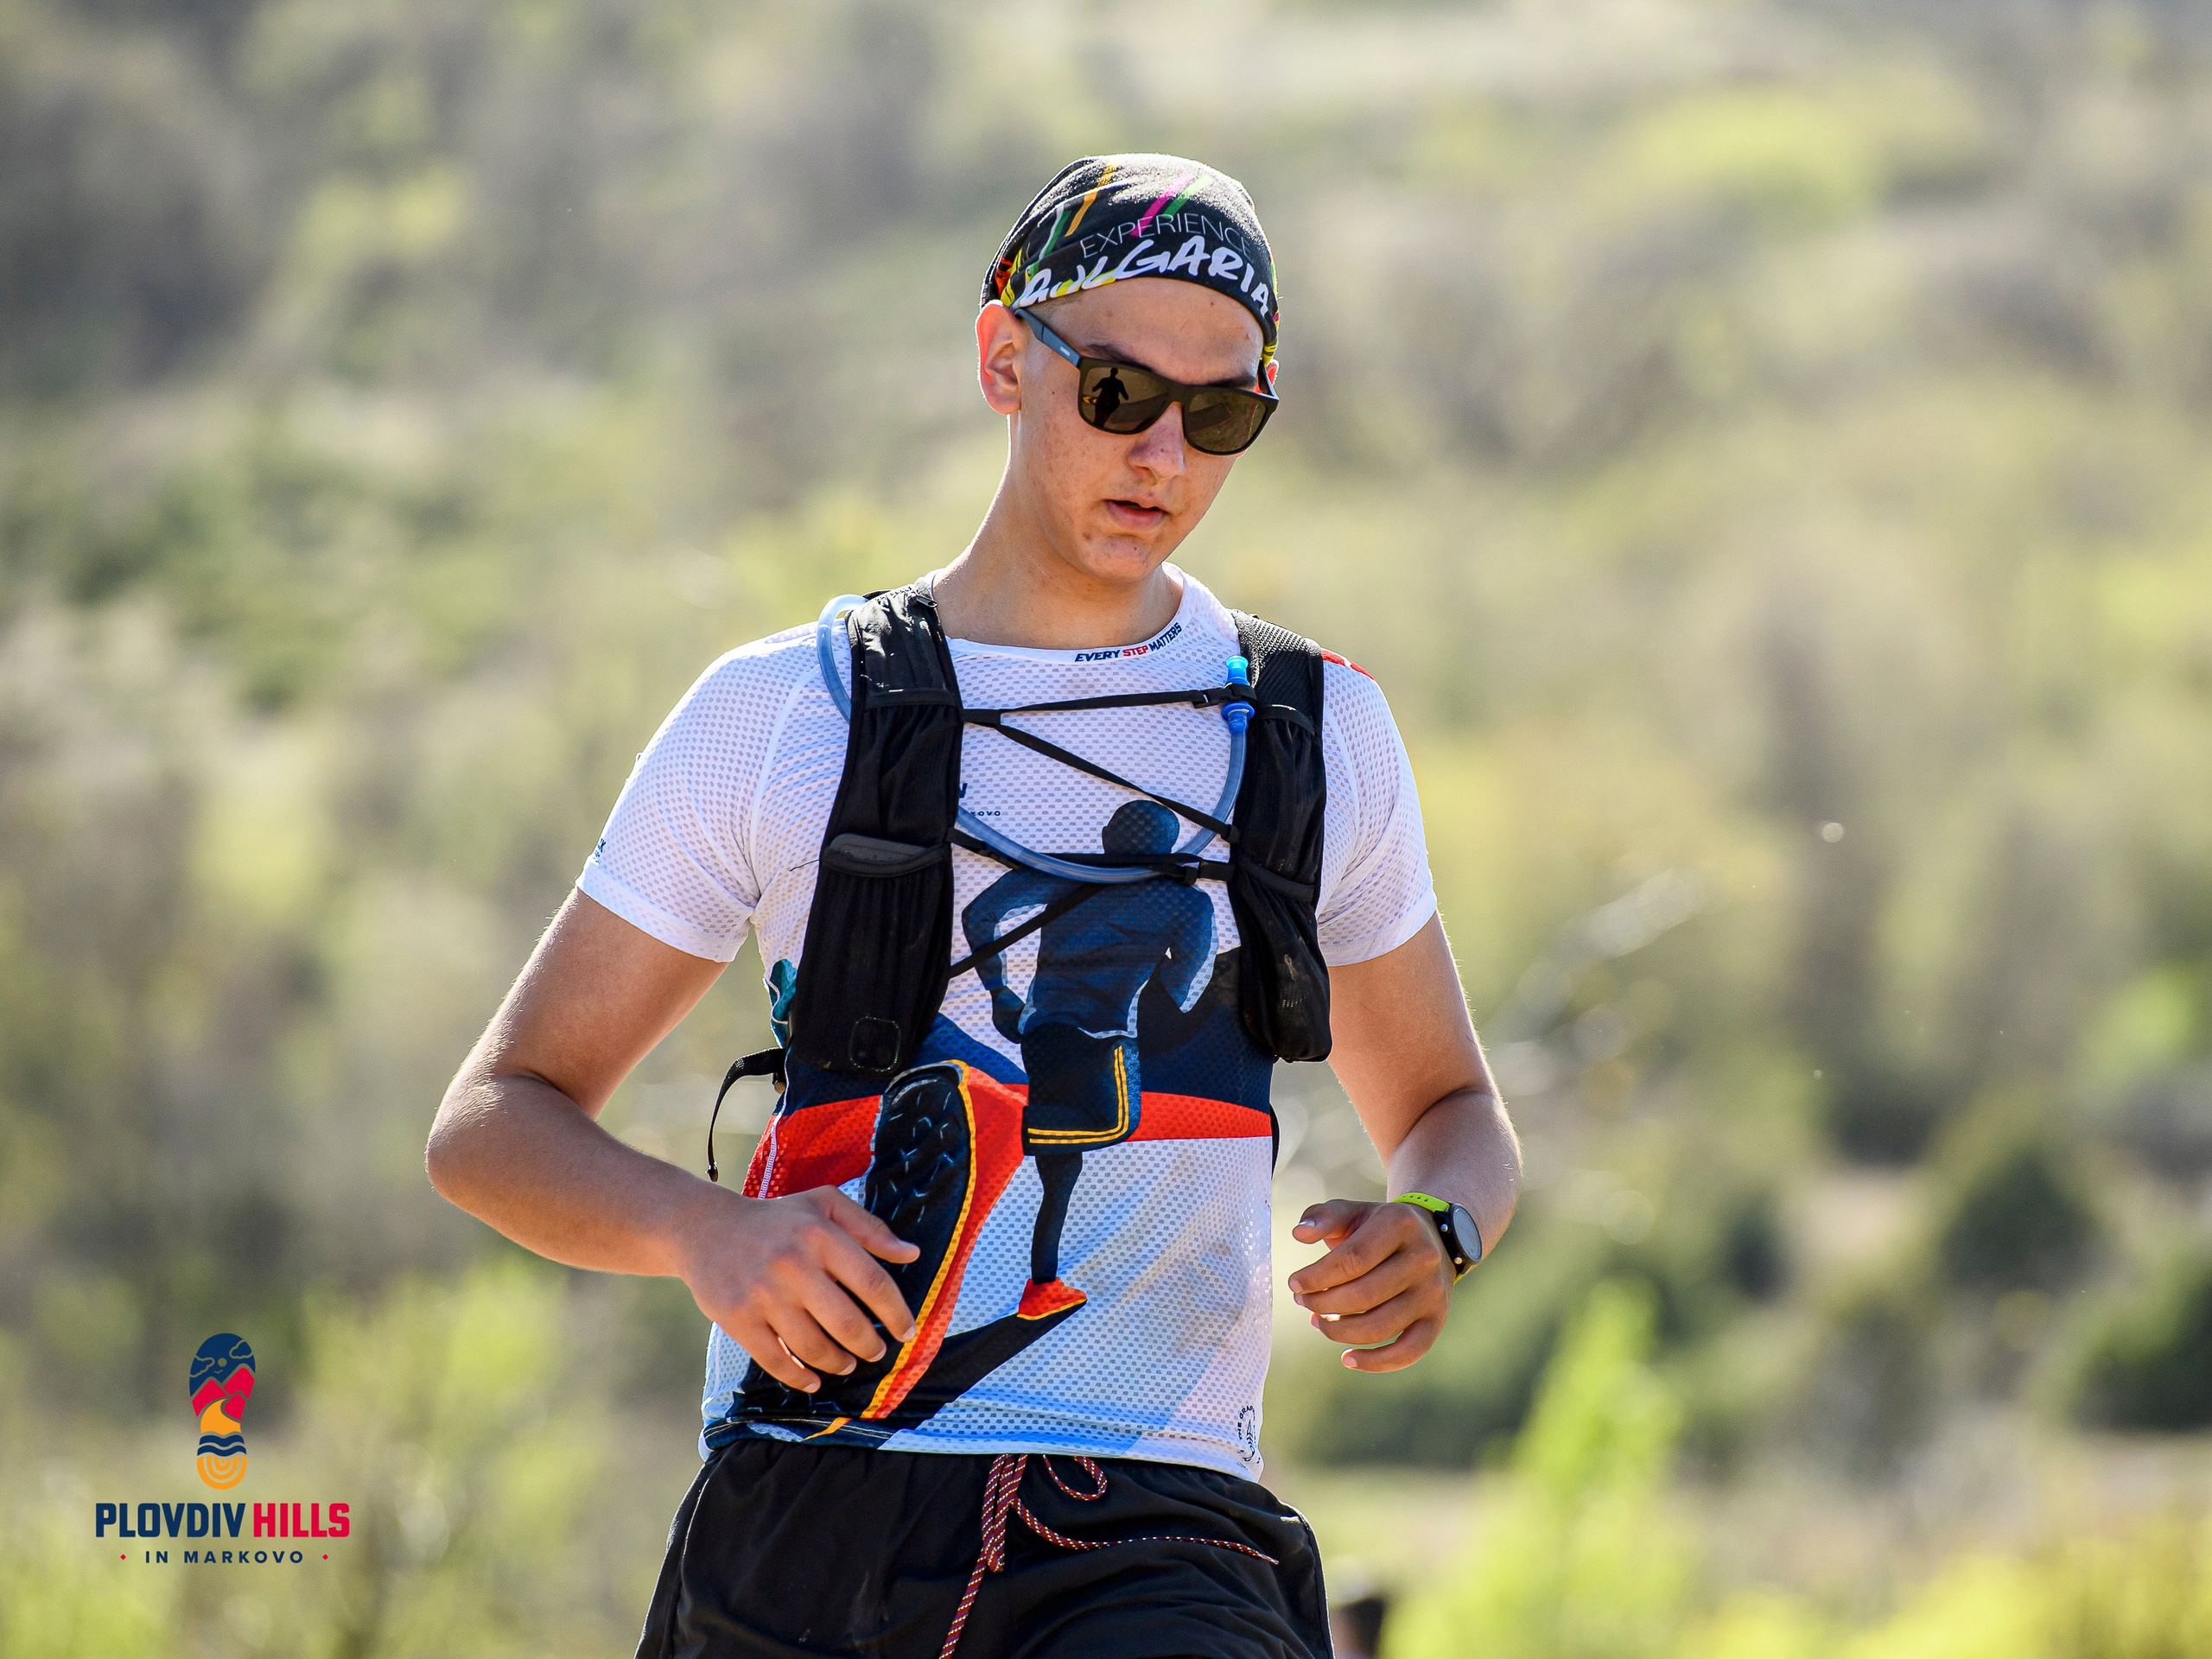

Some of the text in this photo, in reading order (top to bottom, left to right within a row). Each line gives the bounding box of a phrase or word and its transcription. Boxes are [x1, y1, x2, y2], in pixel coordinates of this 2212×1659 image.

[1079, 213, 1253, 260] EXPERIENCE
[1075, 622, 1183, 663] EVERY STEP MATTERS
